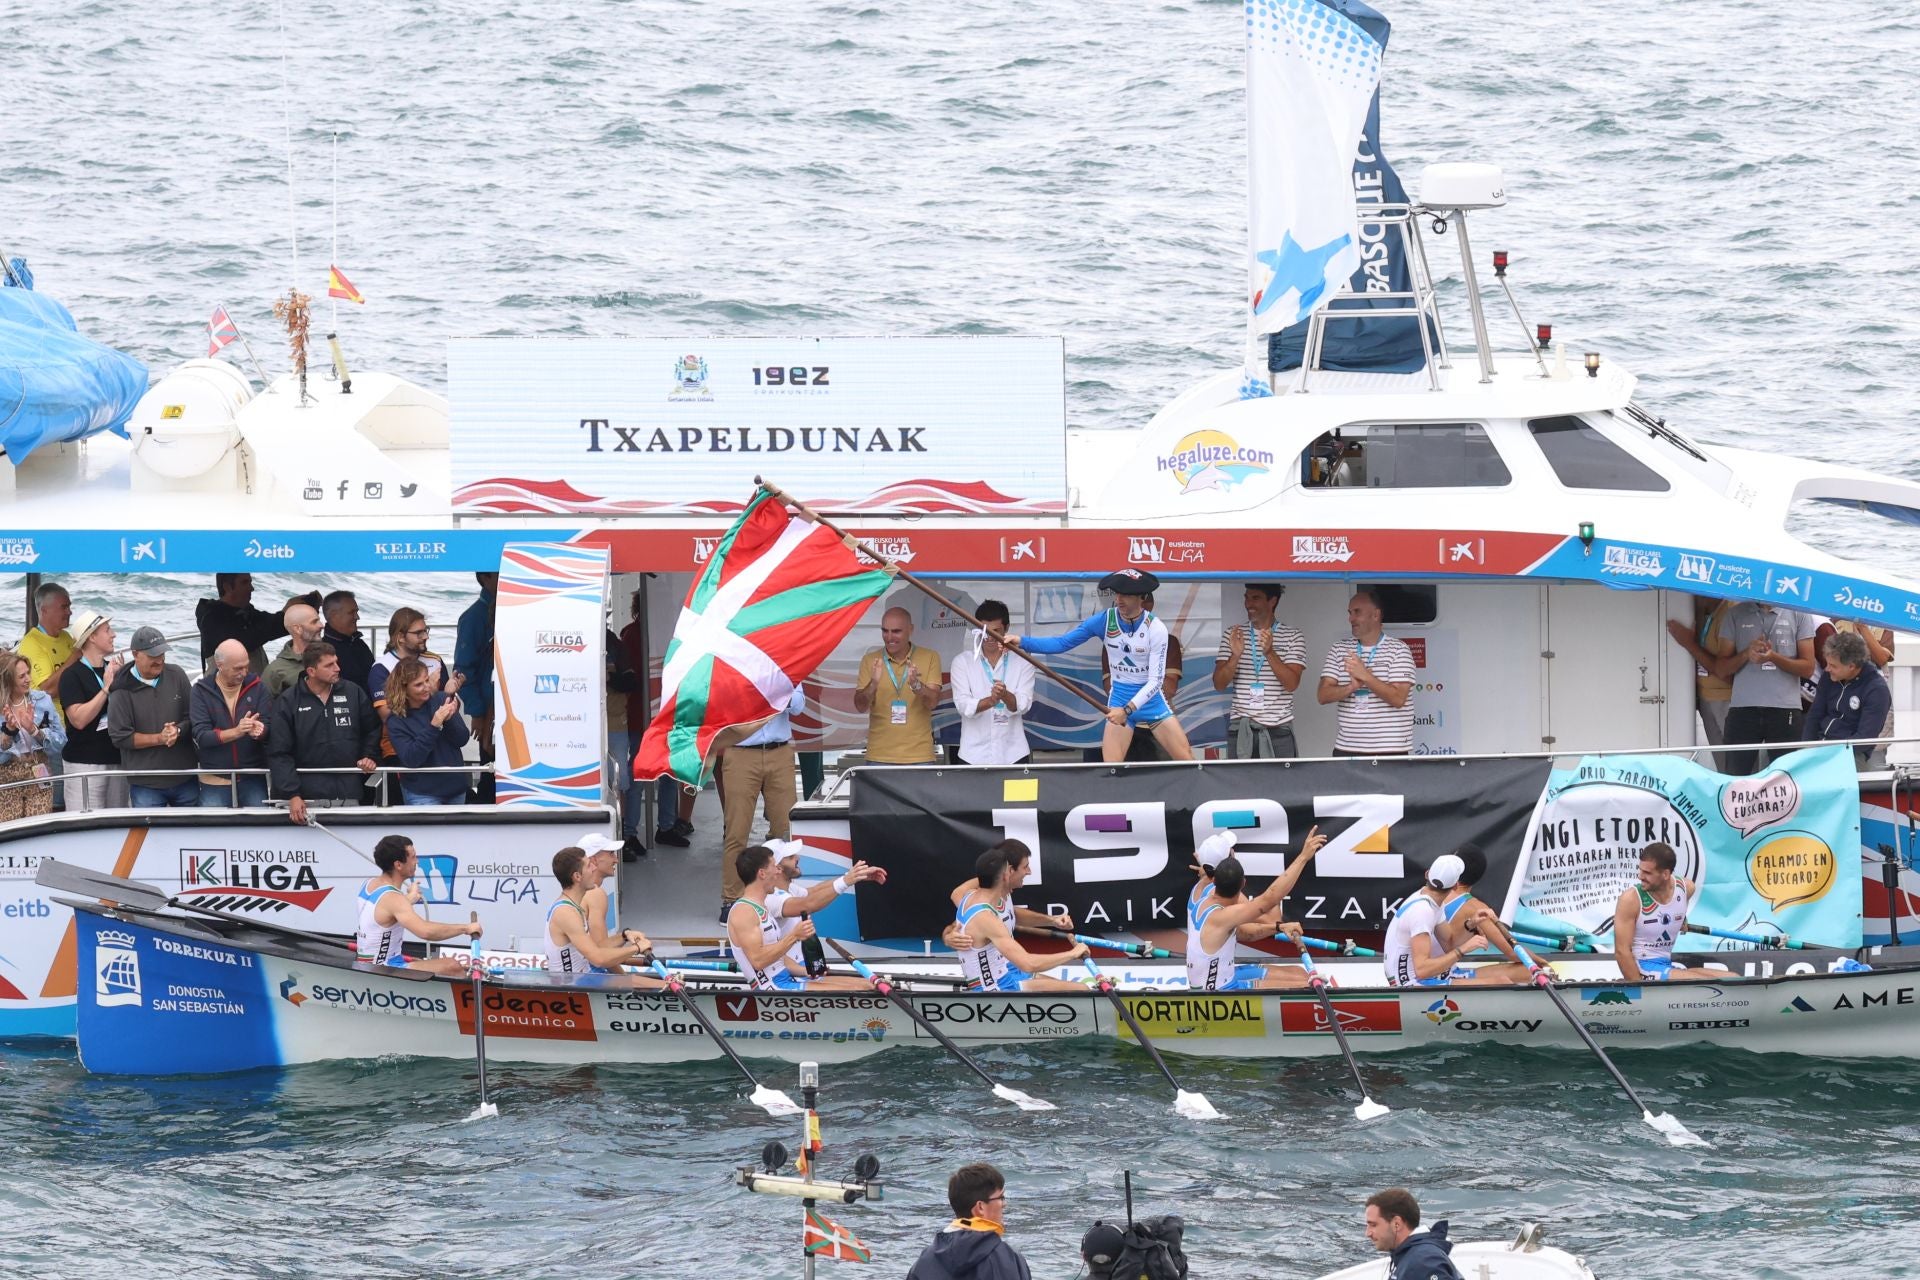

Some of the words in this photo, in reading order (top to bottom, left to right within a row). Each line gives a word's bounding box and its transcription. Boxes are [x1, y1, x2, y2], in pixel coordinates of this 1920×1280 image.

[1156, 441, 1274, 472] hegaluze.com
[263, 544, 295, 559] eitb
[374, 542, 448, 554] KELER
[875, 544, 911, 555] LIGA
[1312, 542, 1349, 553] LIGA
[1168, 549, 1205, 563] LIGA
[1625, 555, 1661, 568] LIGA
[1852, 595, 1885, 613] eitb
[552, 635, 583, 646] LIGA
[562, 683, 589, 694] LIGA
[548, 713, 582, 722] CaixaBank
[1580, 766, 1606, 780] ORIO
[1617, 769, 1668, 793] ZARAUTZ
[1672, 791, 1710, 830] ZUMAIA
[1774, 785, 1787, 797] EN
[1734, 799, 1785, 819] EUSKARA?
[1595, 817, 1681, 848] ETORRI
[230, 850, 274, 863] EUSKO
[279, 850, 319, 864] LABEL
[1539, 847, 1612, 871] EUSKARAREN
[1756, 853, 1808, 869] FALAMOS
[1814, 854, 1828, 867] EN
[467, 861, 539, 875] euskotren
[232, 864, 320, 890] LIGA
[1766, 872, 1819, 886] EUSCARO?
[467, 877, 541, 904] LIGA
[1543, 884, 1569, 896] WELCOME
[1572, 884, 1580, 892] TO
[4, 898, 51, 918] eitb
[152, 937, 237, 965] TORREKUA
[241, 955, 253, 968] II
[977, 950, 995, 987] DRUCK
[168, 985, 226, 999] DONOSTIA
[312, 984, 448, 1013] serviobras
[1832, 987, 1915, 1011] AME
[152, 999, 177, 1012] SAN
[179, 1000, 245, 1015] SEBASTIÁN
[460, 989, 584, 1016] Fdenet
[758, 997, 889, 1010] vascastec
[1668, 1002, 1680, 1010] ICE
[760, 1008, 821, 1023] solar
[921, 1002, 1077, 1023] BOKADO
[1606, 1009, 1643, 1017] SPORT
[487, 1014, 576, 1029] omunica
[1455, 1019, 1543, 1033] ORVY
[1671, 1020, 1748, 1030] DRUCK
[722, 1028, 775, 1040] zure
[778, 1027, 871, 1043] energia
[1029, 1026, 1080, 1035] EVENTOS
